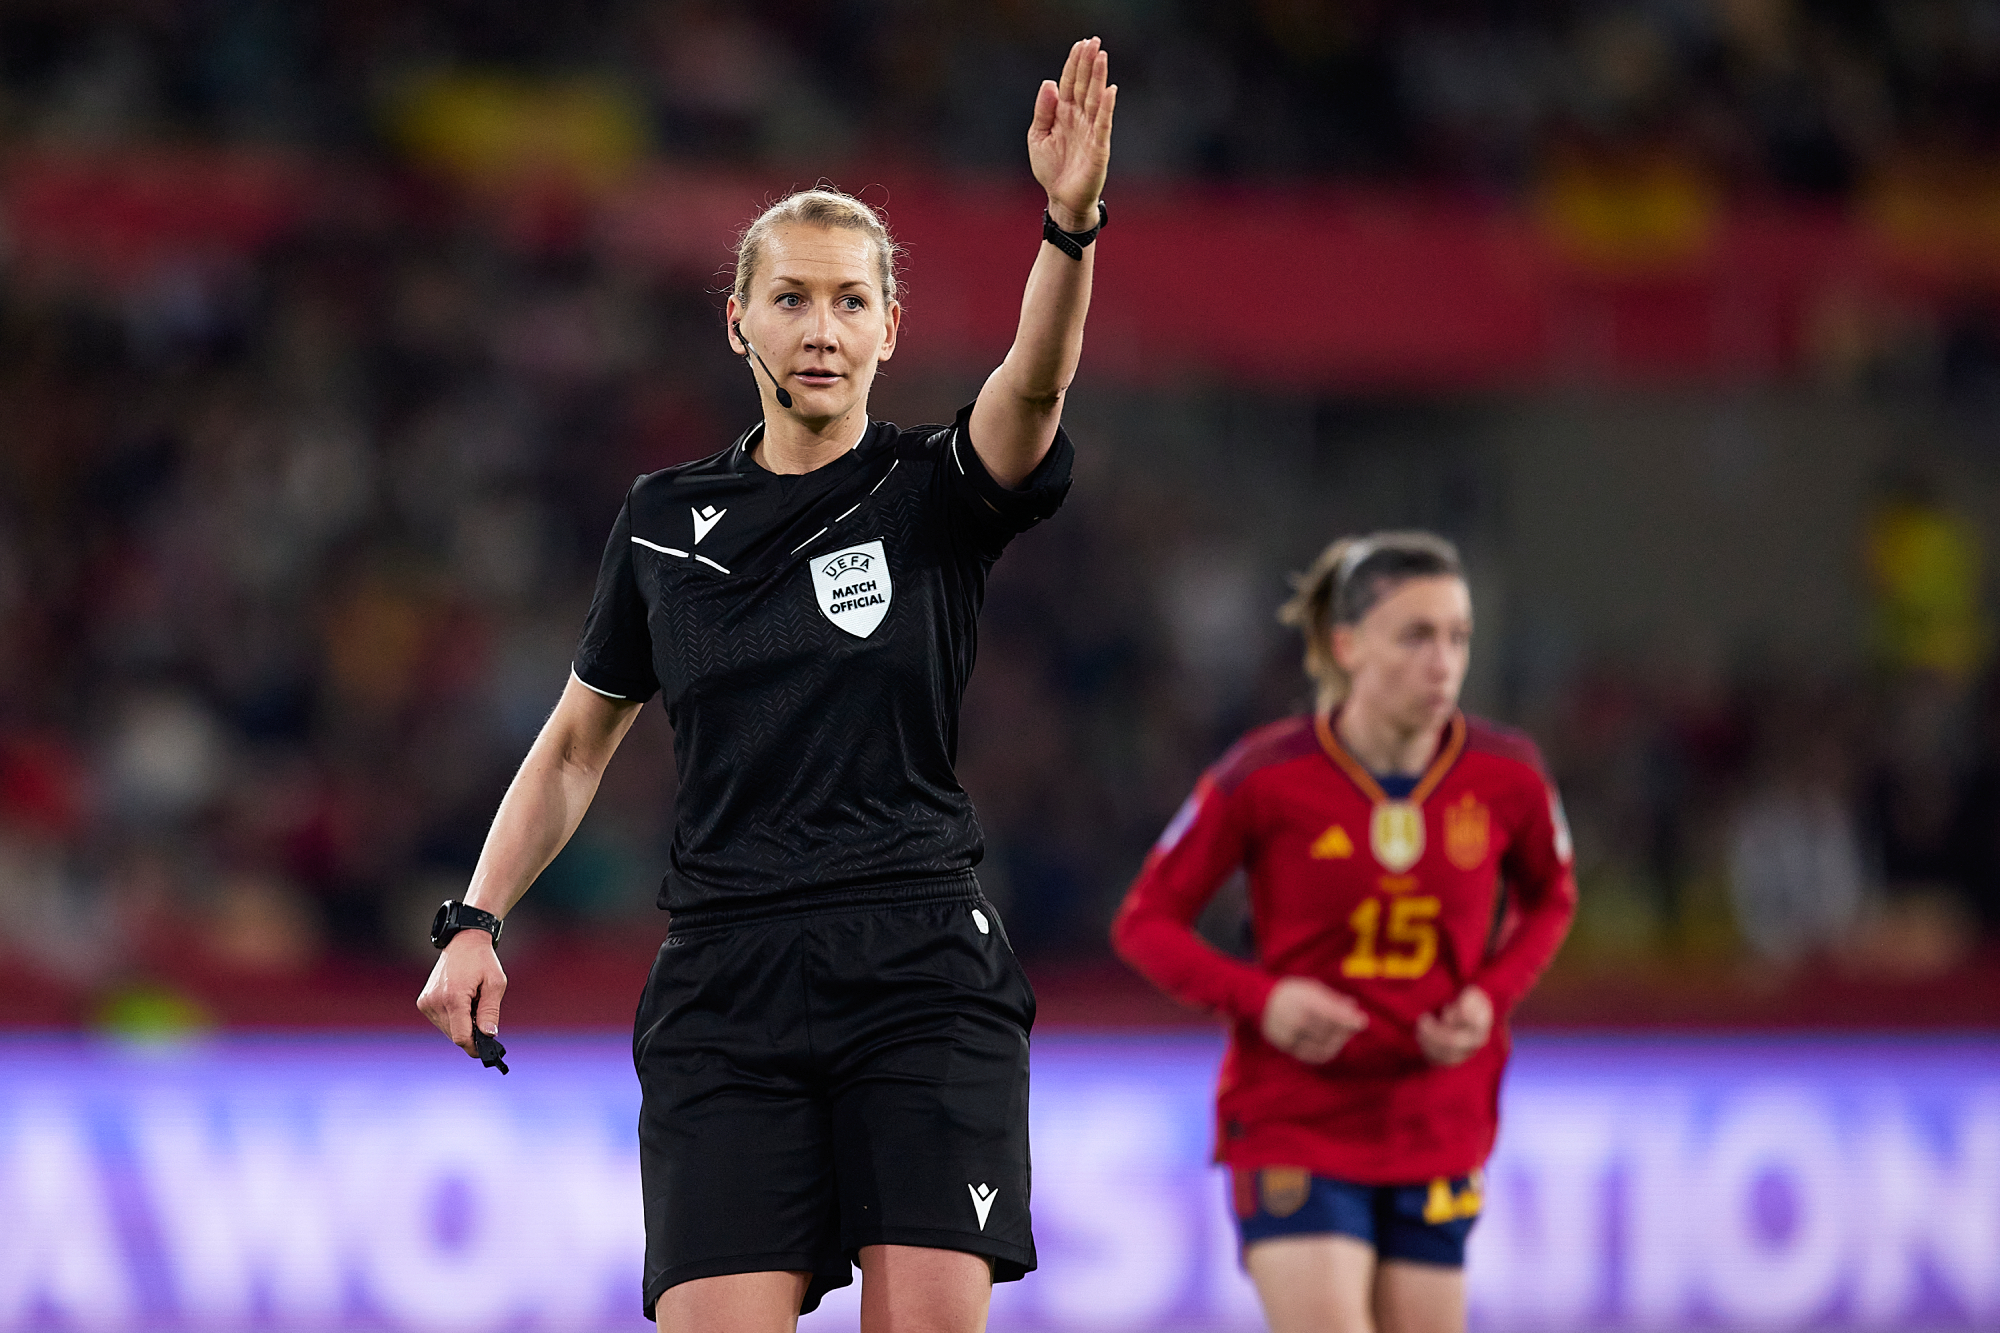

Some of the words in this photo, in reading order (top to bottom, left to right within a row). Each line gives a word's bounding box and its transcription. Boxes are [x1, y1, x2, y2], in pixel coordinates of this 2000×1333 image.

[825, 555, 870, 577] UEFA
[832, 580, 877, 600] MATCH
[829, 593, 886, 614] OFFICIAL
[1340, 896, 1441, 979] 15
